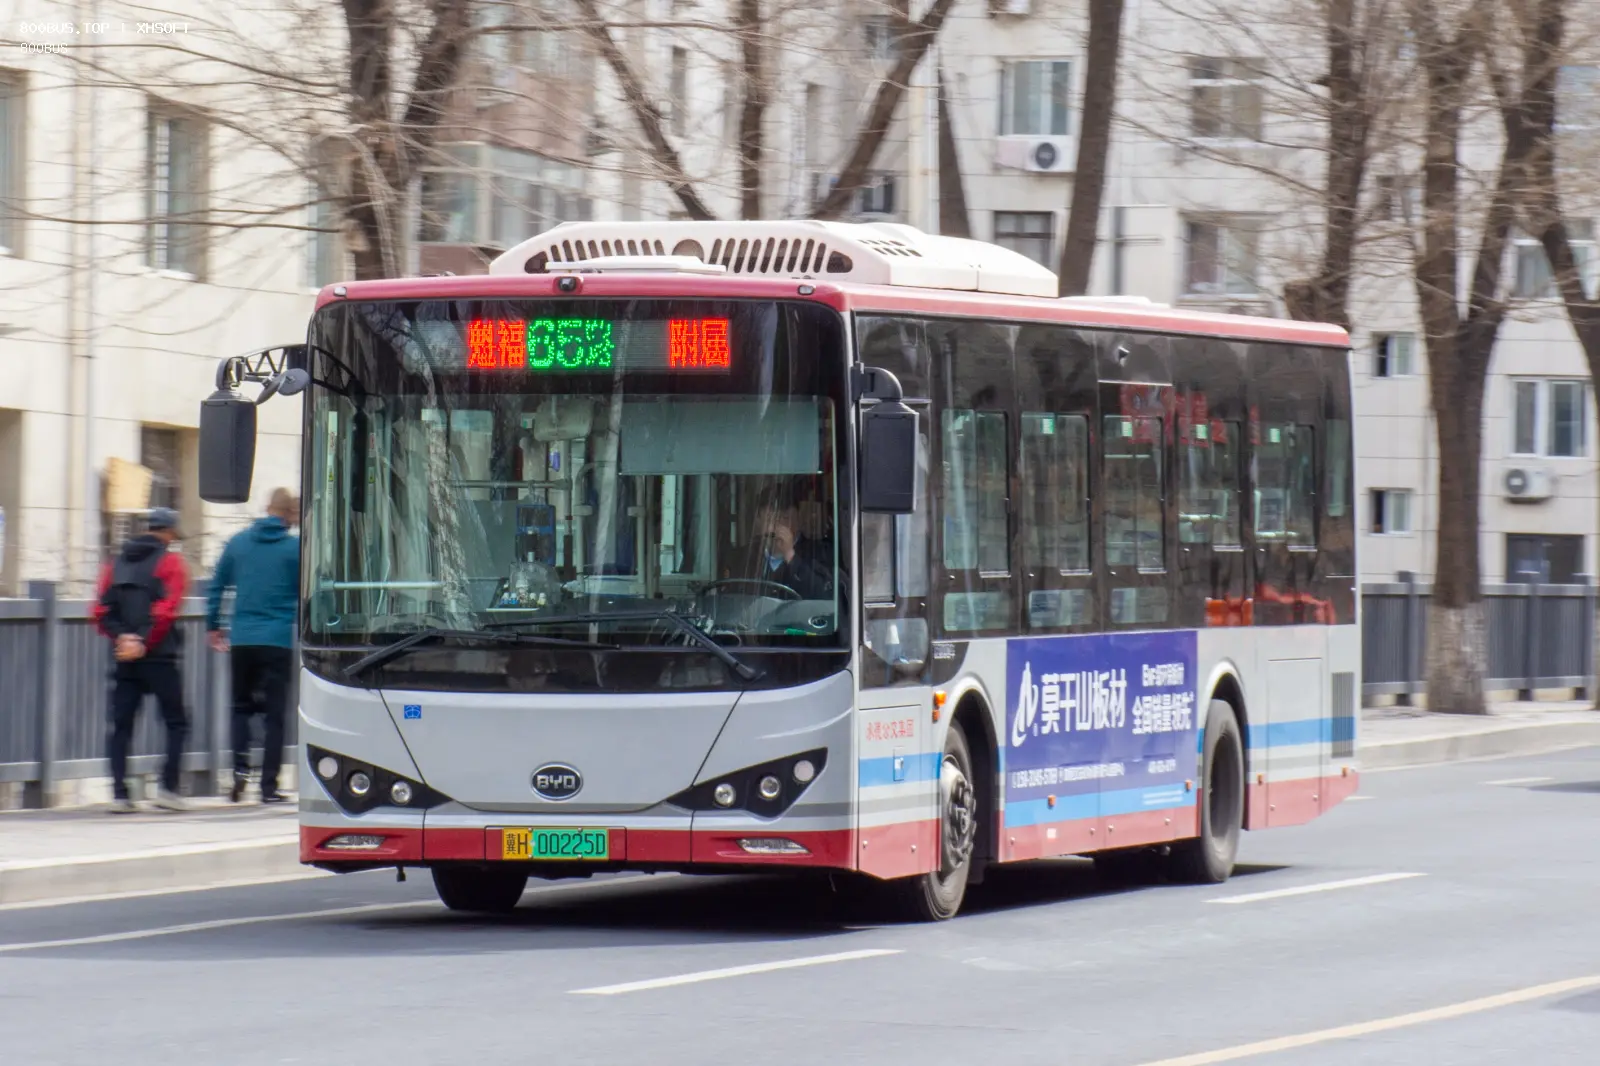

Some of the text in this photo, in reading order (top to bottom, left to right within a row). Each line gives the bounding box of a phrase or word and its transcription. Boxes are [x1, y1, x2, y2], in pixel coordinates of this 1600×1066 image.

[668, 318, 731, 368] 附属
[1041, 668, 1127, 735] 莫干山板材
[536, 775, 576, 789] BYD
